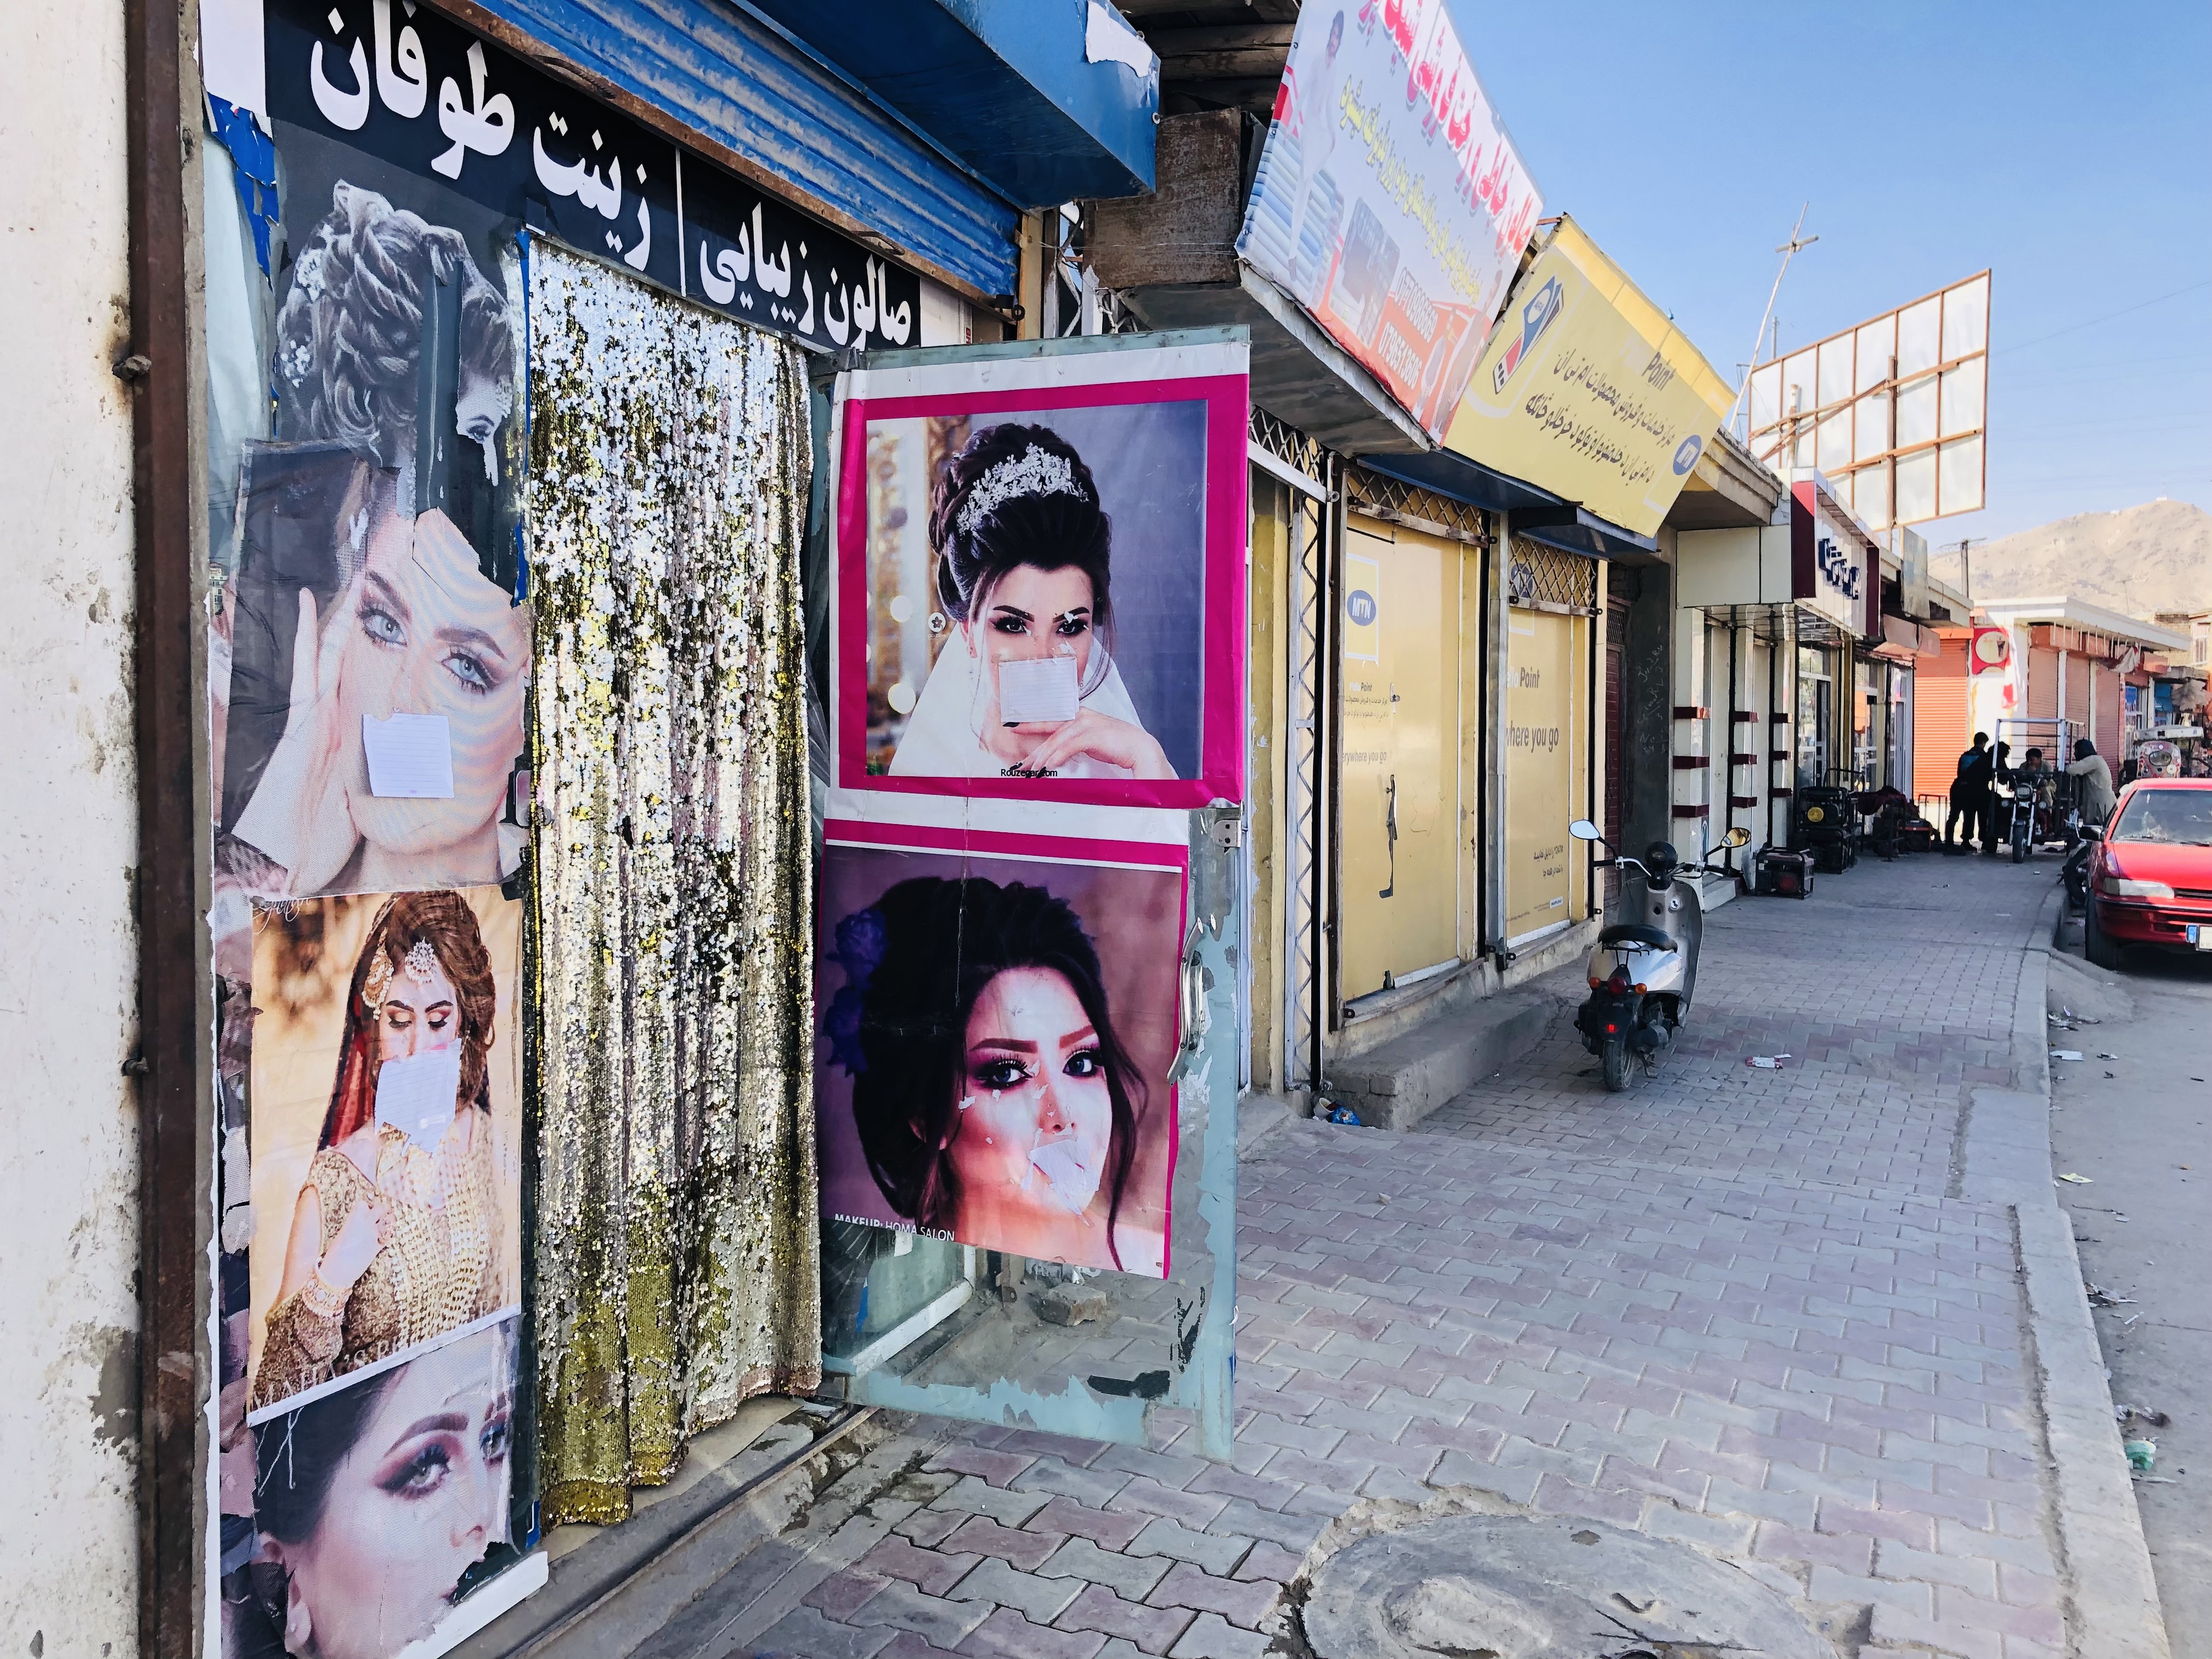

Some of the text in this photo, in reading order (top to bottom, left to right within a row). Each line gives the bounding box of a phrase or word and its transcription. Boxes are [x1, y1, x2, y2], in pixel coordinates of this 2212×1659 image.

[1407, 26, 1535, 259] صالون خیاطی و رخت فروشی
[311, 0, 911, 351] صالون زیبایی زینت طوفان
[1394, 266, 1439, 344] 0770986669
[1378, 321, 1423, 391] 0796513606
[1641, 351, 1677, 392] Point
[1352, 597, 1372, 619] MTN
[1361, 681, 1373, 692] Point
[1520, 666, 1541, 689] Point
[1531, 726, 1547, 754] you
[1548, 726, 1560, 753] go
[1368, 752, 1379, 765] you
[1380, 751, 1387, 765] go
[1000, 768, 1058, 779] Rouzegarom
[885, 1221, 917, 1235] HOMA
[920, 1226, 955, 1242] SALON
